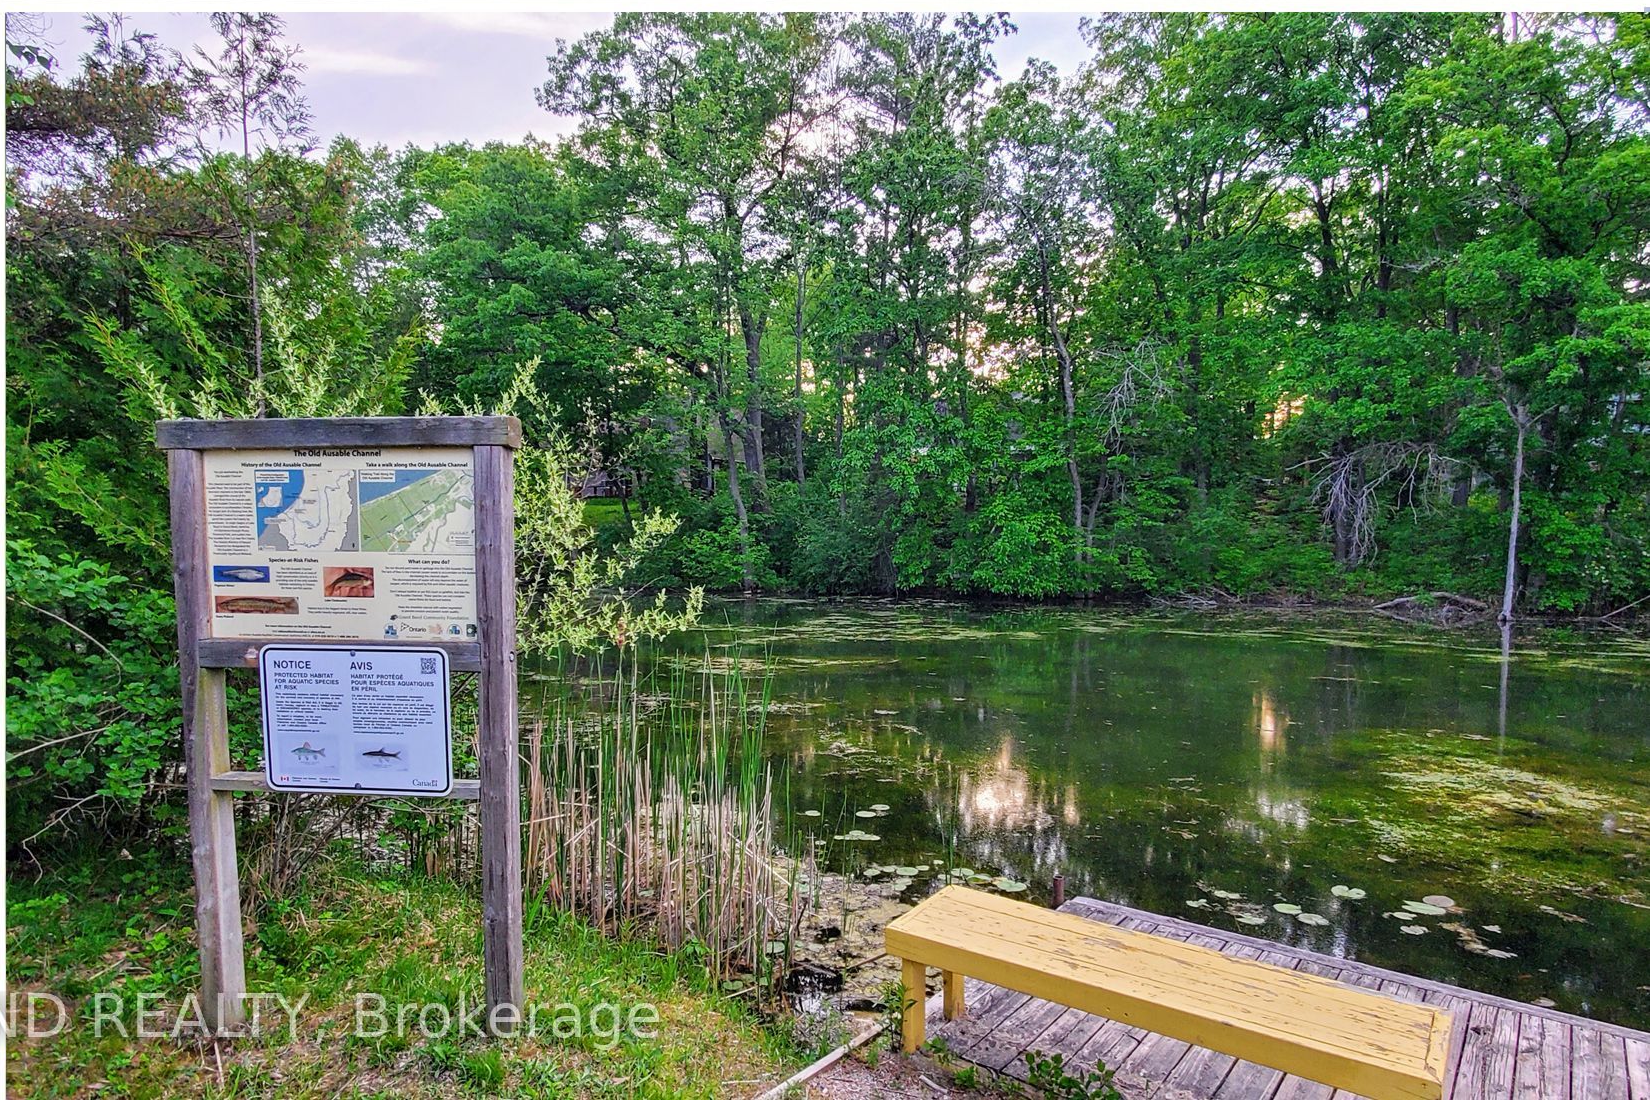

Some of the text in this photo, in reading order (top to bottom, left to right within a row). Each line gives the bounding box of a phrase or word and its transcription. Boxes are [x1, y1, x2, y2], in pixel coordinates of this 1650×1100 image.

[273, 660, 312, 670] NOTICE
[350, 661, 373, 671] AVIS
[412, 778, 438, 787] Canada
